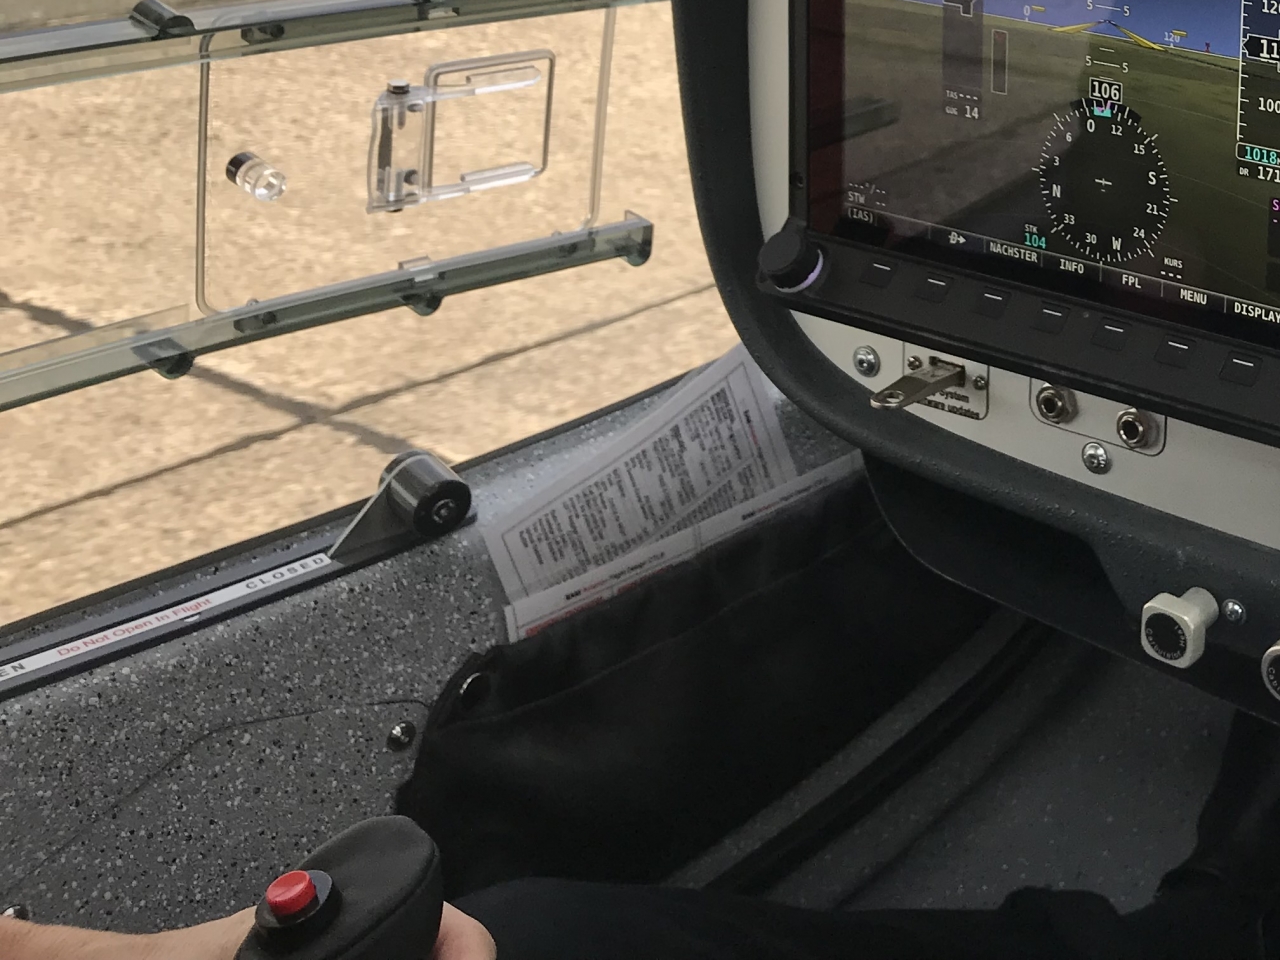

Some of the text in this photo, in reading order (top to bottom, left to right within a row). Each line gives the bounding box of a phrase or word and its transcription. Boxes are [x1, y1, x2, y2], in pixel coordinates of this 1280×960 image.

[1092, 81, 1120, 101] 106
[1244, 146, 1277, 165] 1018
[1024, 233, 1047, 249] 104
[847, 207, 873, 224] (IAS)
[1059, 258, 1085, 274] INFO
[1122, 273, 1142, 289] FPL
[1180, 287, 1208, 305] MENU
[245, 555, 326, 591] CLOSED
[57, 642, 81, 657] Do
[83, 632, 111, 649] Not
[112, 617, 154, 638] Open
[172, 597, 213, 619] Flight
